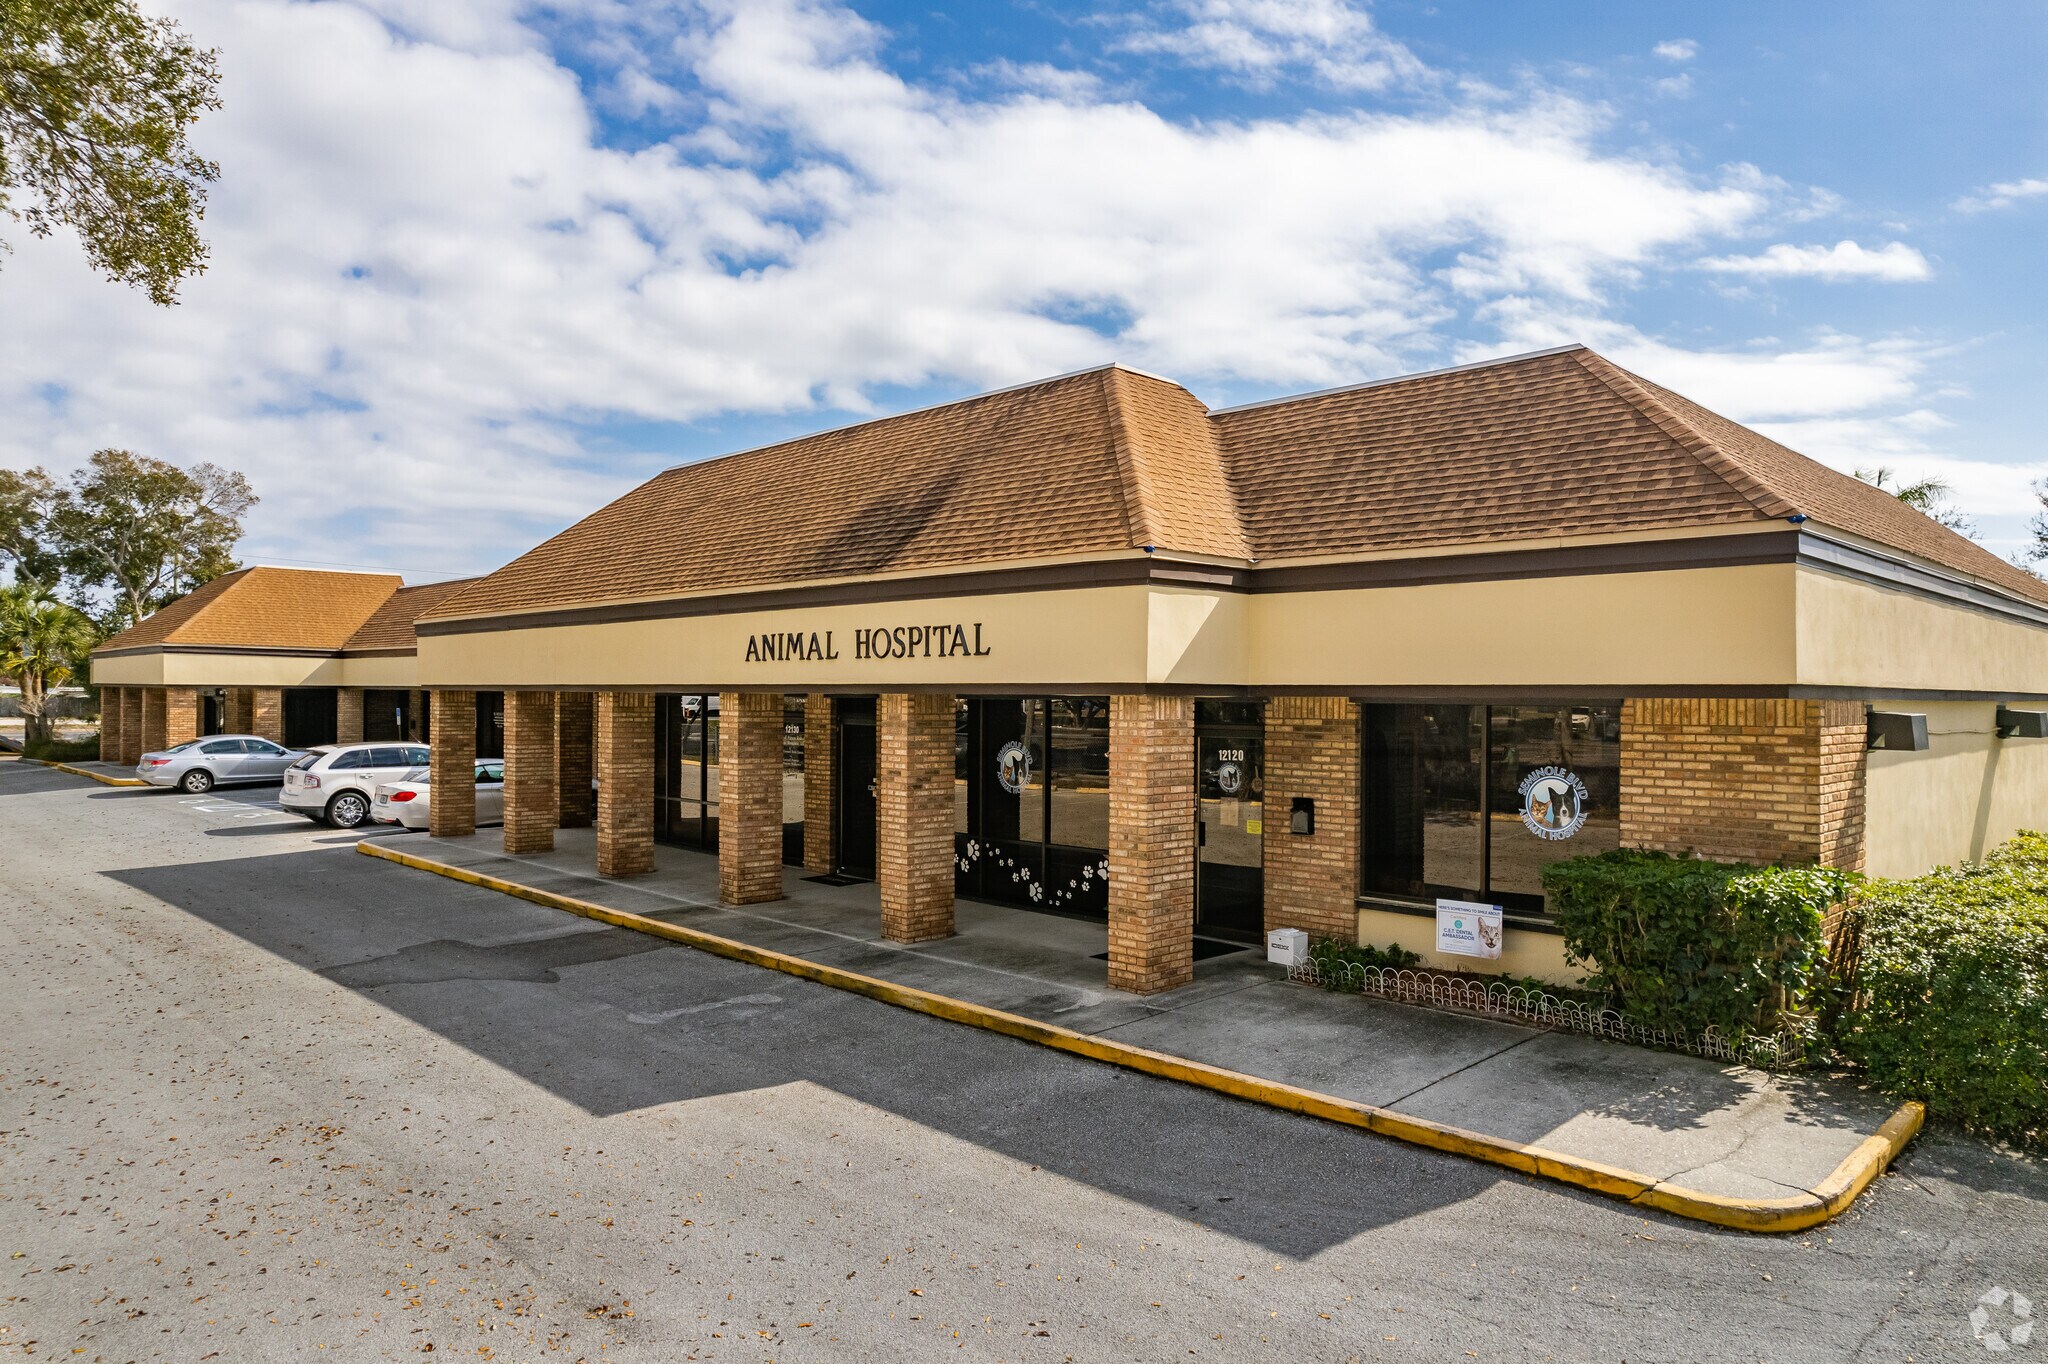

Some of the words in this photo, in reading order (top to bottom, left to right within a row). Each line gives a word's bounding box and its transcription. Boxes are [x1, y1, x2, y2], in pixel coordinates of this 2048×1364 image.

[745, 631, 839, 662] ANIMAL
[855, 623, 991, 660] HOSPITAL
[1219, 749, 1244, 761] 12120
[1518, 766, 1566, 796] SEMINOLE
[1566, 772, 1589, 800] BLVD
[1518, 808, 1547, 839] ANIMAL
[1549, 812, 1589, 841] HOSPITAL
[1442, 932, 1475, 941] AMBASSADOR
[1456, 928, 1473, 936] DENTAL
